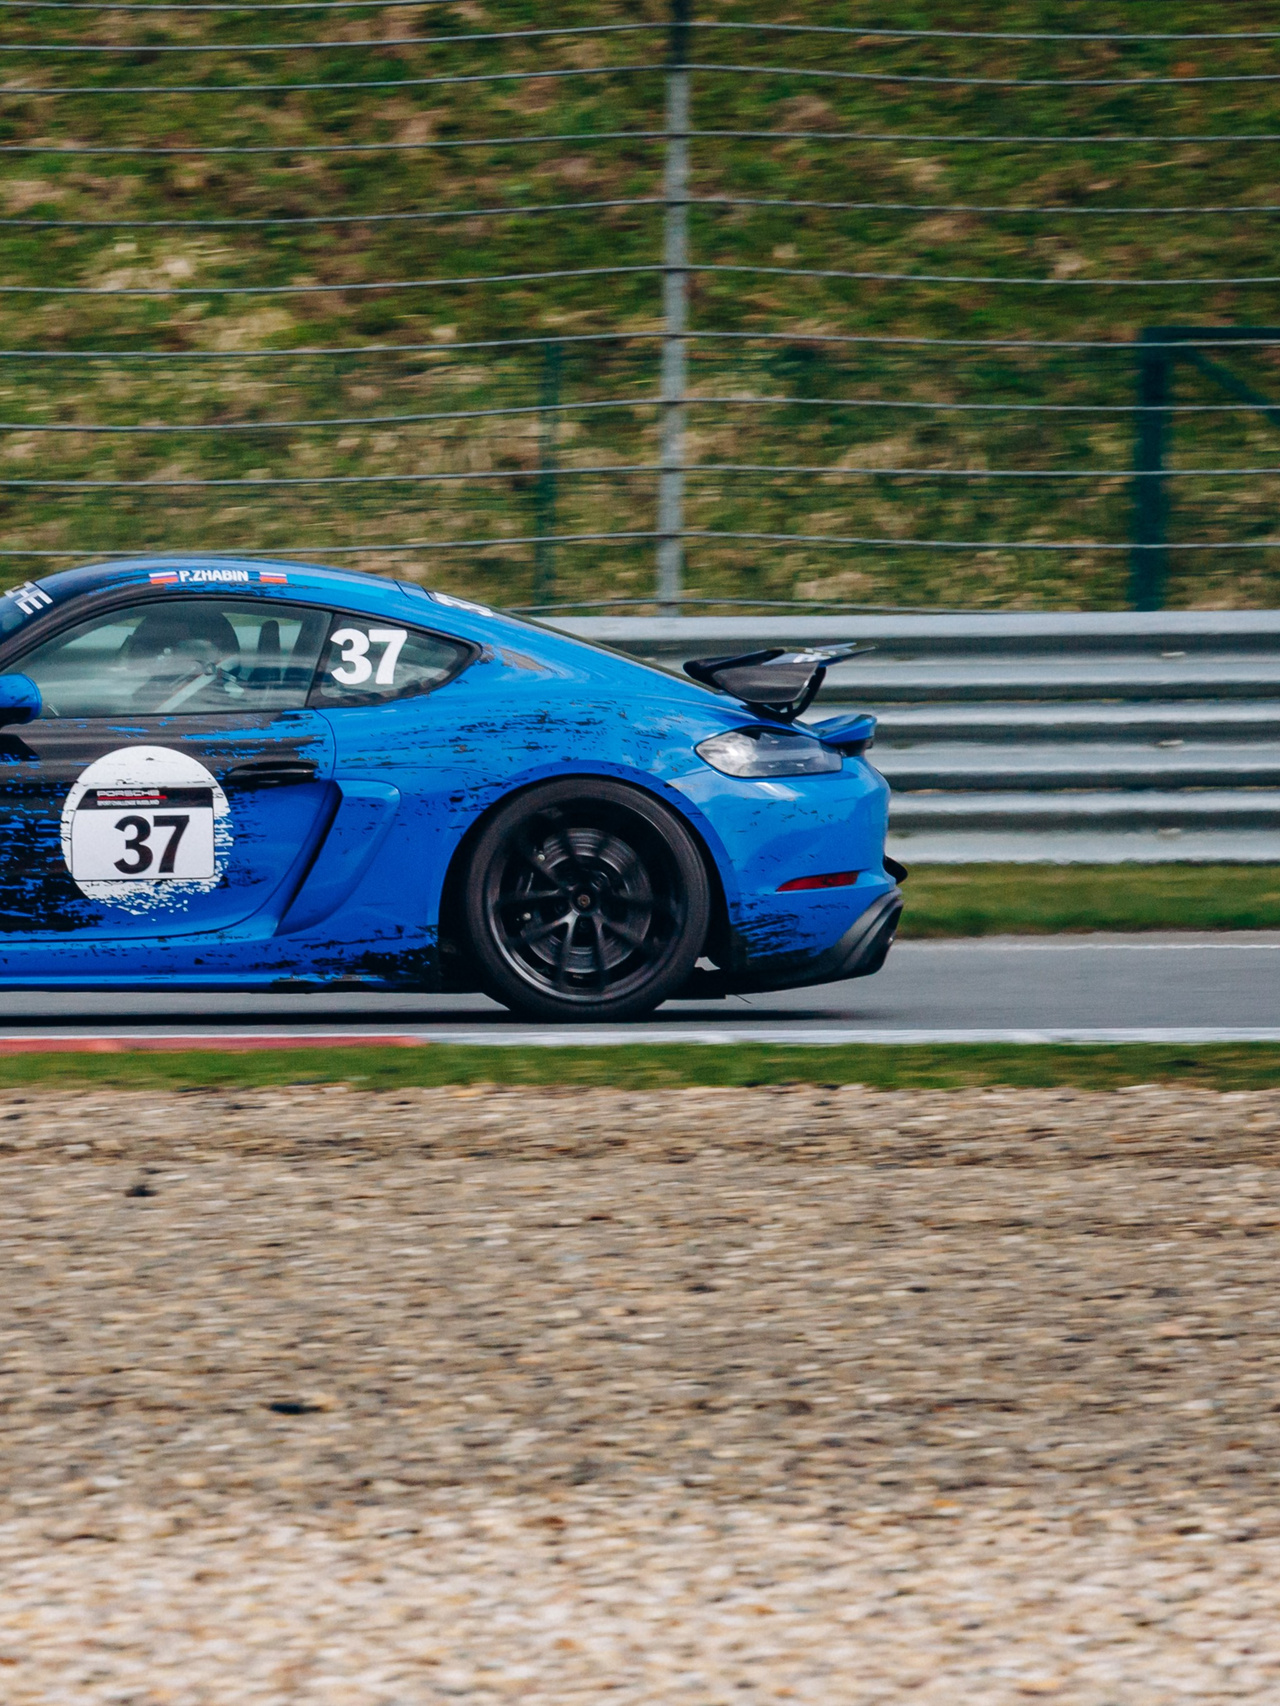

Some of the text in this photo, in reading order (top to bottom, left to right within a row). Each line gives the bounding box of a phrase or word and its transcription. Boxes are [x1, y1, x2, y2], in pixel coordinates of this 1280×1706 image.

[180, 570, 249, 582] P.ZHABIN
[330, 628, 408, 685] 37
[113, 815, 190, 875] 37
